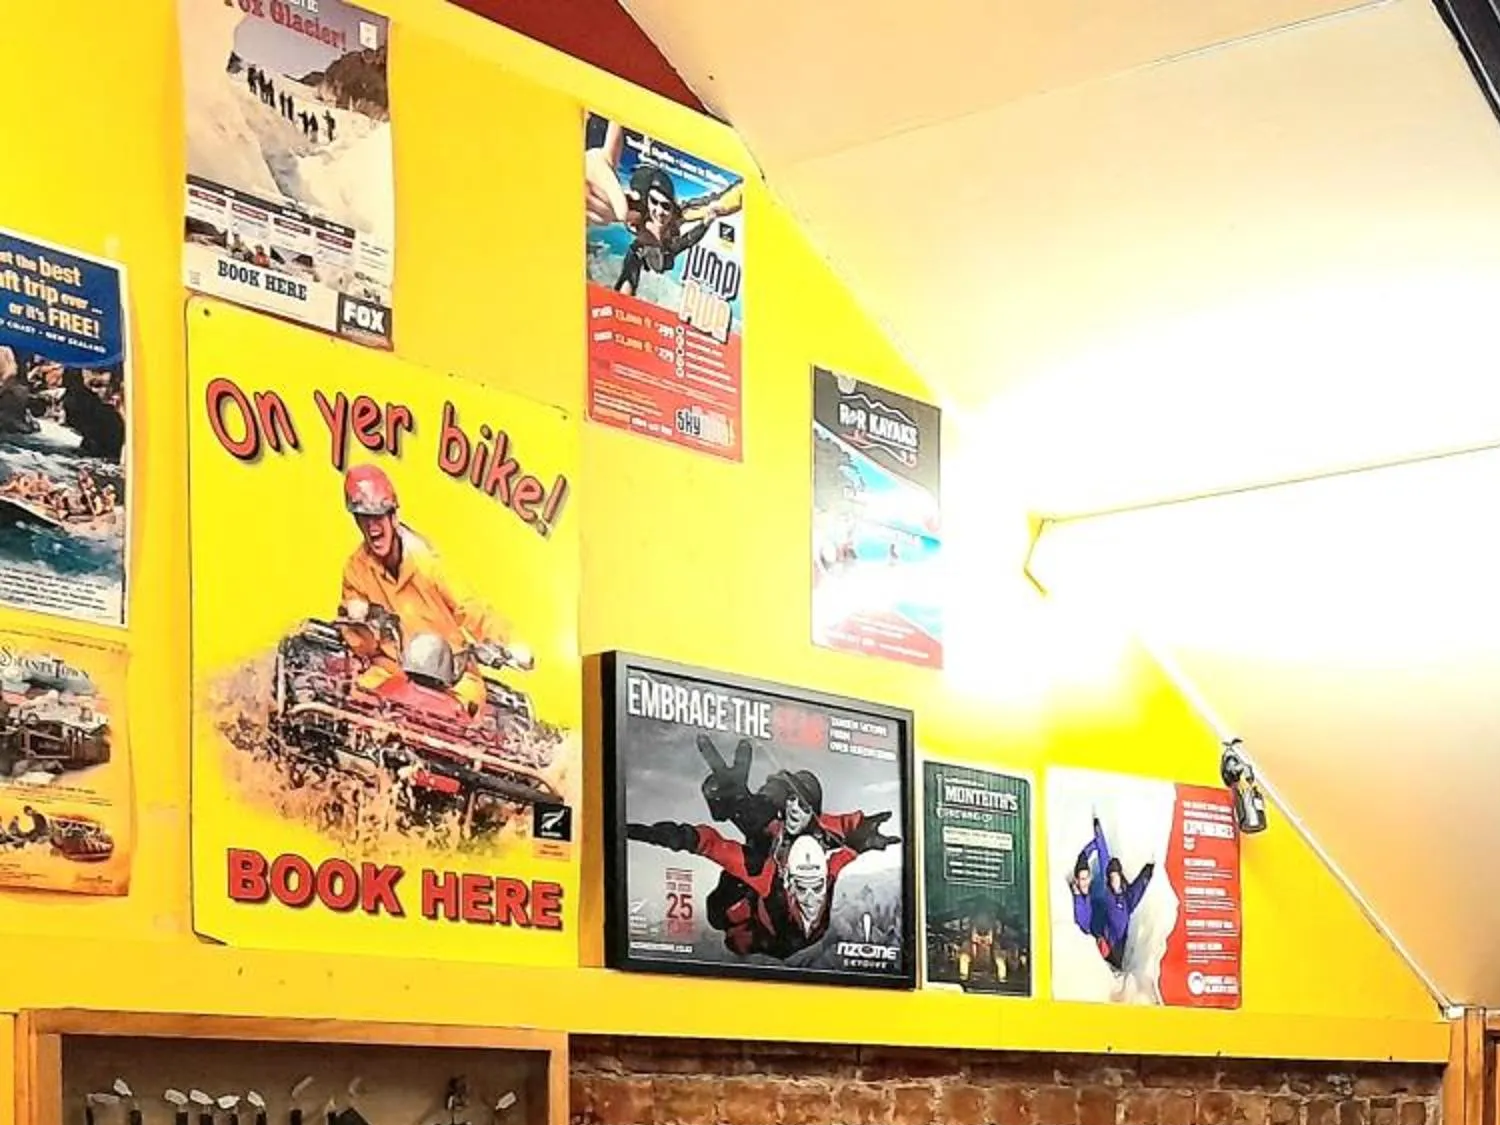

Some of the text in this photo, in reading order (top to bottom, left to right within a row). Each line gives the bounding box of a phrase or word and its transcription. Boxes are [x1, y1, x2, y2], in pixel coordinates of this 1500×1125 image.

[269, 2, 347, 51] Glacier!
[0, 269, 20, 293] aft
[23, 275, 59, 305] trip
[61, 294, 88, 310] ever
[16, 253, 36, 271] the
[39, 255, 81, 287] best
[217, 259, 308, 302] BOOK HERE
[8, 302, 100, 339] or it's FREE!
[343, 301, 385, 334] FOX
[869, 413, 918, 447] KAYAKS
[205, 377, 568, 538] On yer bike!
[627, 677, 730, 732] EMBRACE
[731, 697, 773, 739] THE
[945, 785, 1018, 811] MONTEITH'S
[227, 848, 564, 932] BOOK HERE
[665, 892, 693, 920] 25
